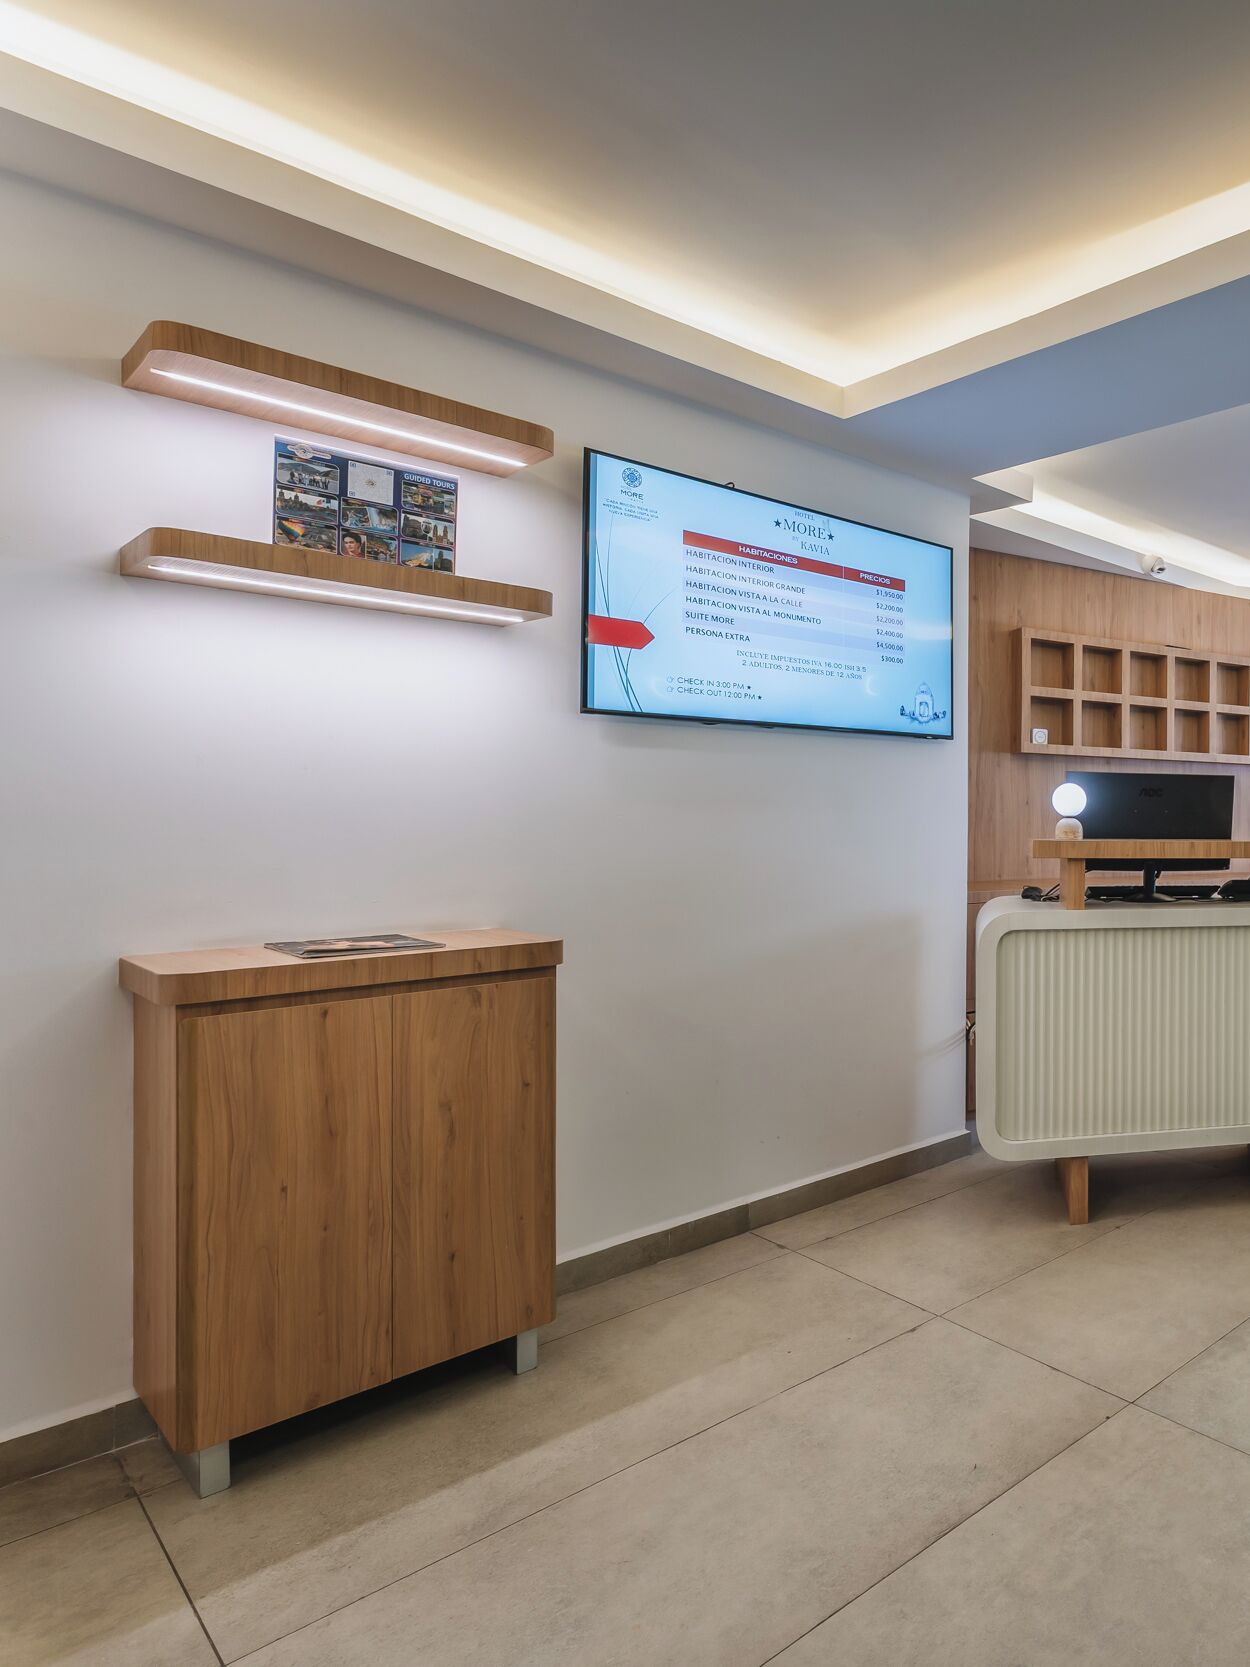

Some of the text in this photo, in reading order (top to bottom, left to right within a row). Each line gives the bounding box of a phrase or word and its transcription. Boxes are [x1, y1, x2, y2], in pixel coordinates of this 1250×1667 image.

[404, 473, 455, 490] GUIDED TOURS
[620, 489, 644, 501] MORE
[794, 510, 816, 521] HOTEL
[783, 518, 826, 540] MORE
[738, 545, 798, 565] HABITACIONES
[801, 541, 830, 556] KAVIA
[686, 549, 775, 574] HABITACION INTERIOR
[685, 565, 806, 595] HABITACION INTERIOR GRANDE
[859, 572, 892, 585] PRECIOS
[685, 580, 737, 596] HABITACION
[738, 590, 760, 601] VISTA
[761, 594, 768, 602] A
[780, 598, 803, 608] CALLE
[876, 589, 904, 600] $1,950.00
[685, 595, 822, 625] HABITACION VISTA AL MONUMENTO
[876, 602, 904, 613] $2,200.00
[685, 610, 735, 625] SUITE MORE
[876, 615, 904, 626] $2,200.00
[685, 626, 751, 642] PERSONA EXTRA
[876, 628, 904, 639] $2,400.00
[876, 641, 904, 652] $4,500.00
[736, 650, 768, 660] INCLUYE
[770, 654, 810, 665] IMPUESTOS
[881, 655, 904, 665] $300.00
[791, 666, 825, 676] MENORES
[677, 677, 704, 686] CHECK
[732, 682, 745, 690] PM
[677, 686, 756, 700] CHECK OUT 12:00 PM
[1138, 787, 1164, 798] AOC
